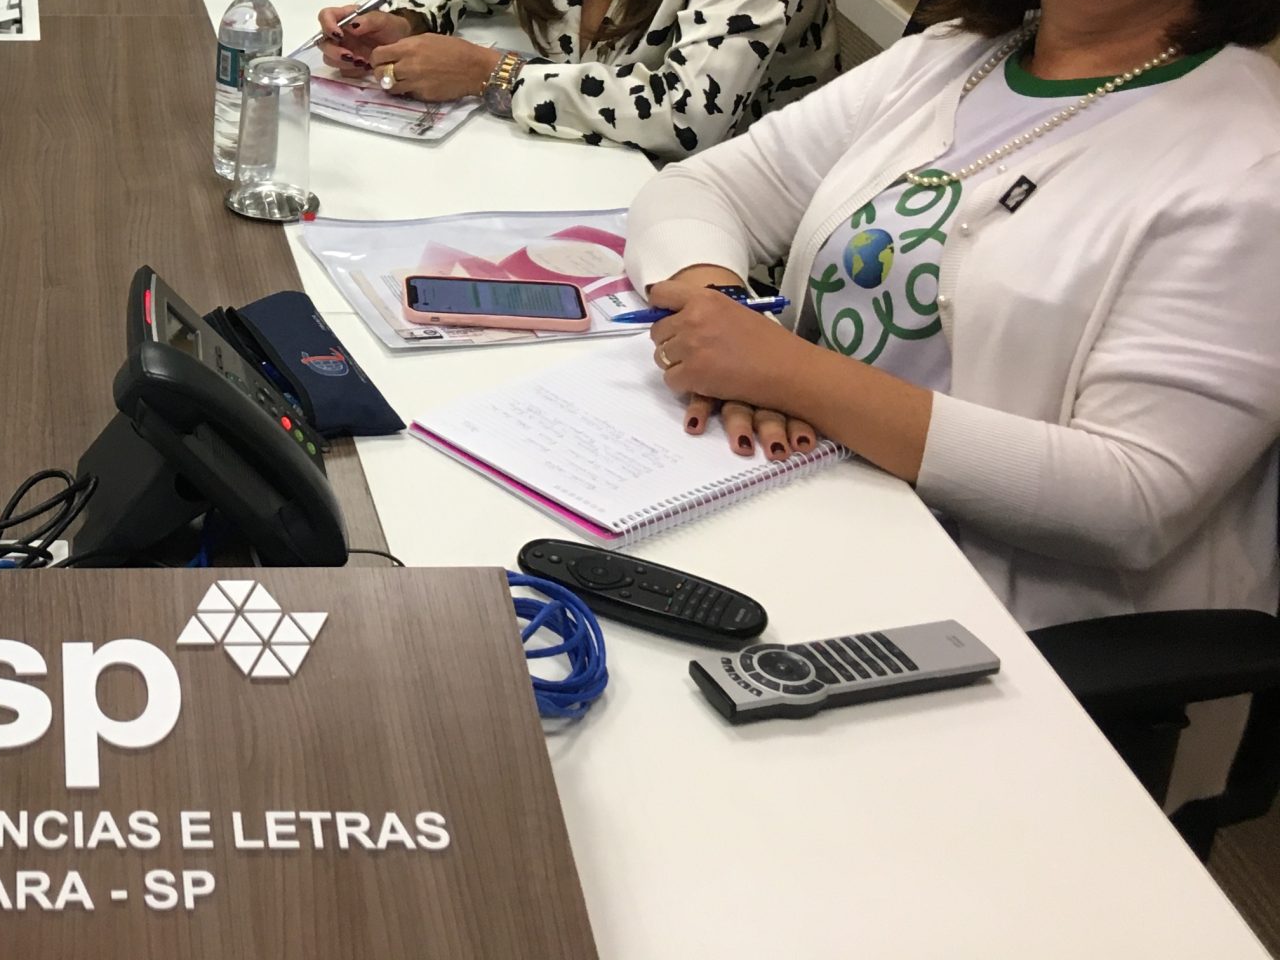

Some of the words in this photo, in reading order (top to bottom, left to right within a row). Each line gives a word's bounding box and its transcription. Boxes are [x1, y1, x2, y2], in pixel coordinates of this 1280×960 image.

[180, 809, 215, 849] E
[232, 809, 452, 851] LETRAS
[109, 888, 129, 901] -
[144, 870, 216, 911] SP
